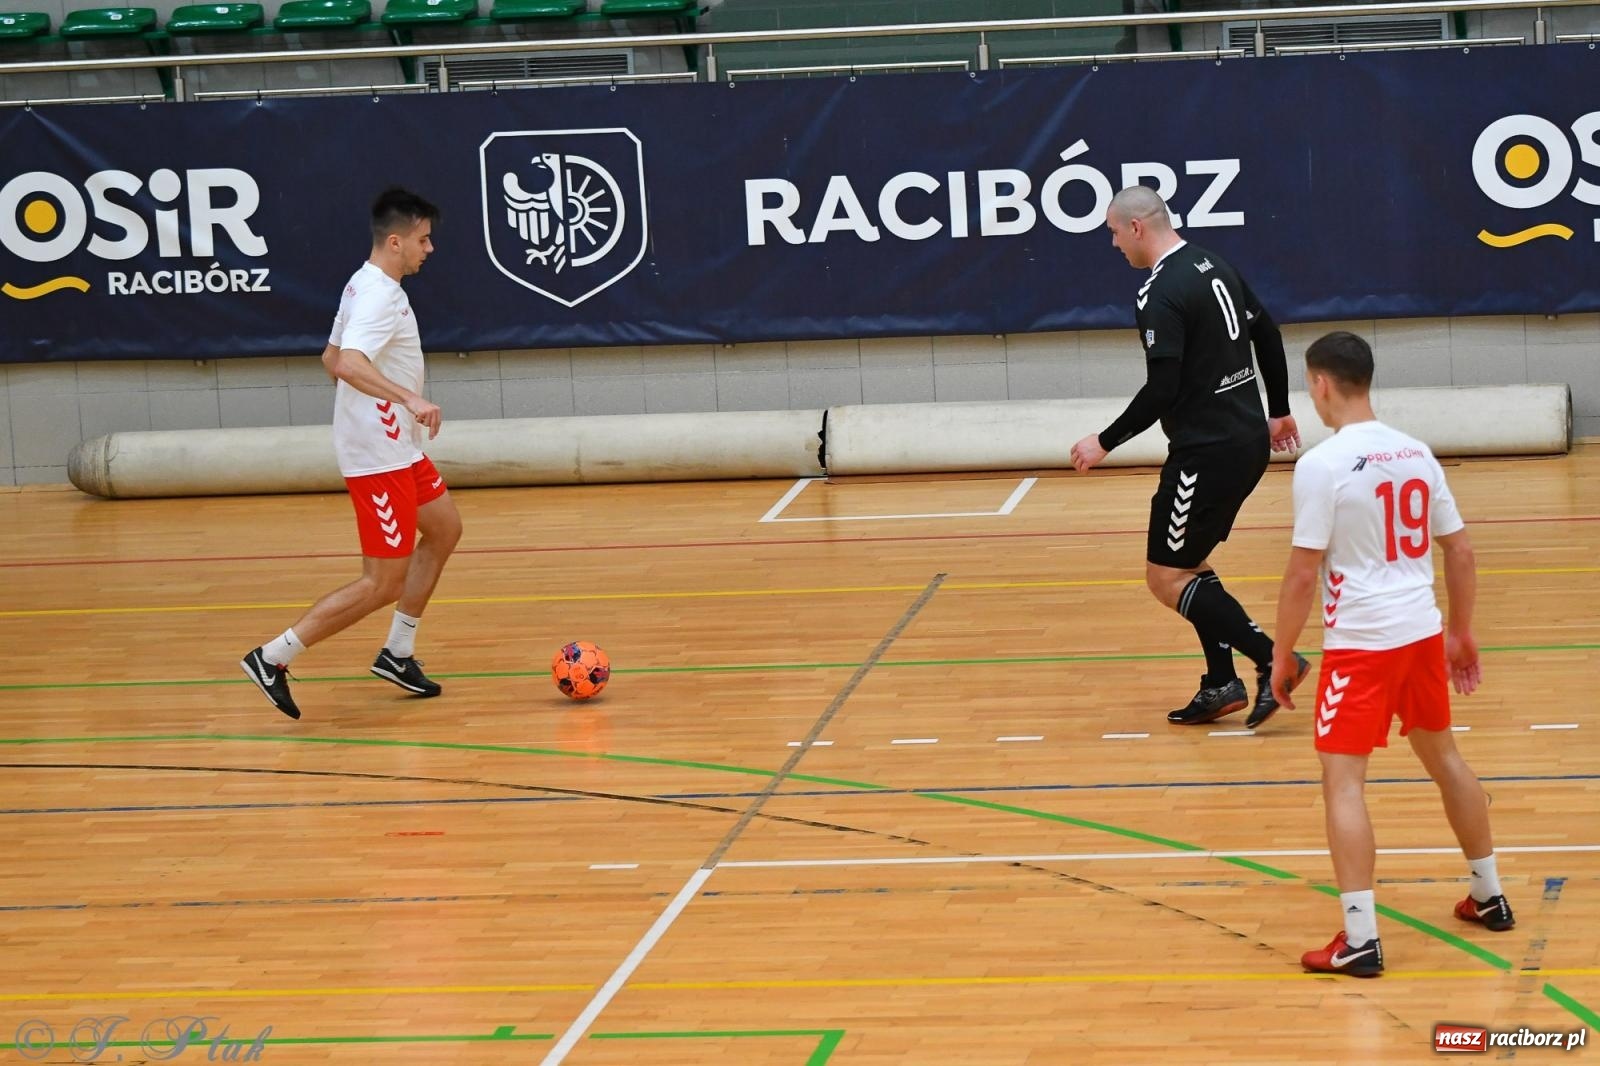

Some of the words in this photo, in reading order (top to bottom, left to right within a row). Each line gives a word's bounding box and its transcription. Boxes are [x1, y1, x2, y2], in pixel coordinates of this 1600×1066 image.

[744, 138, 1245, 246] RACIBÓRZ
[107, 261, 271, 295] RACIBÓRZ
[1211, 278, 1240, 341] 0
[1375, 478, 1430, 562] 19
